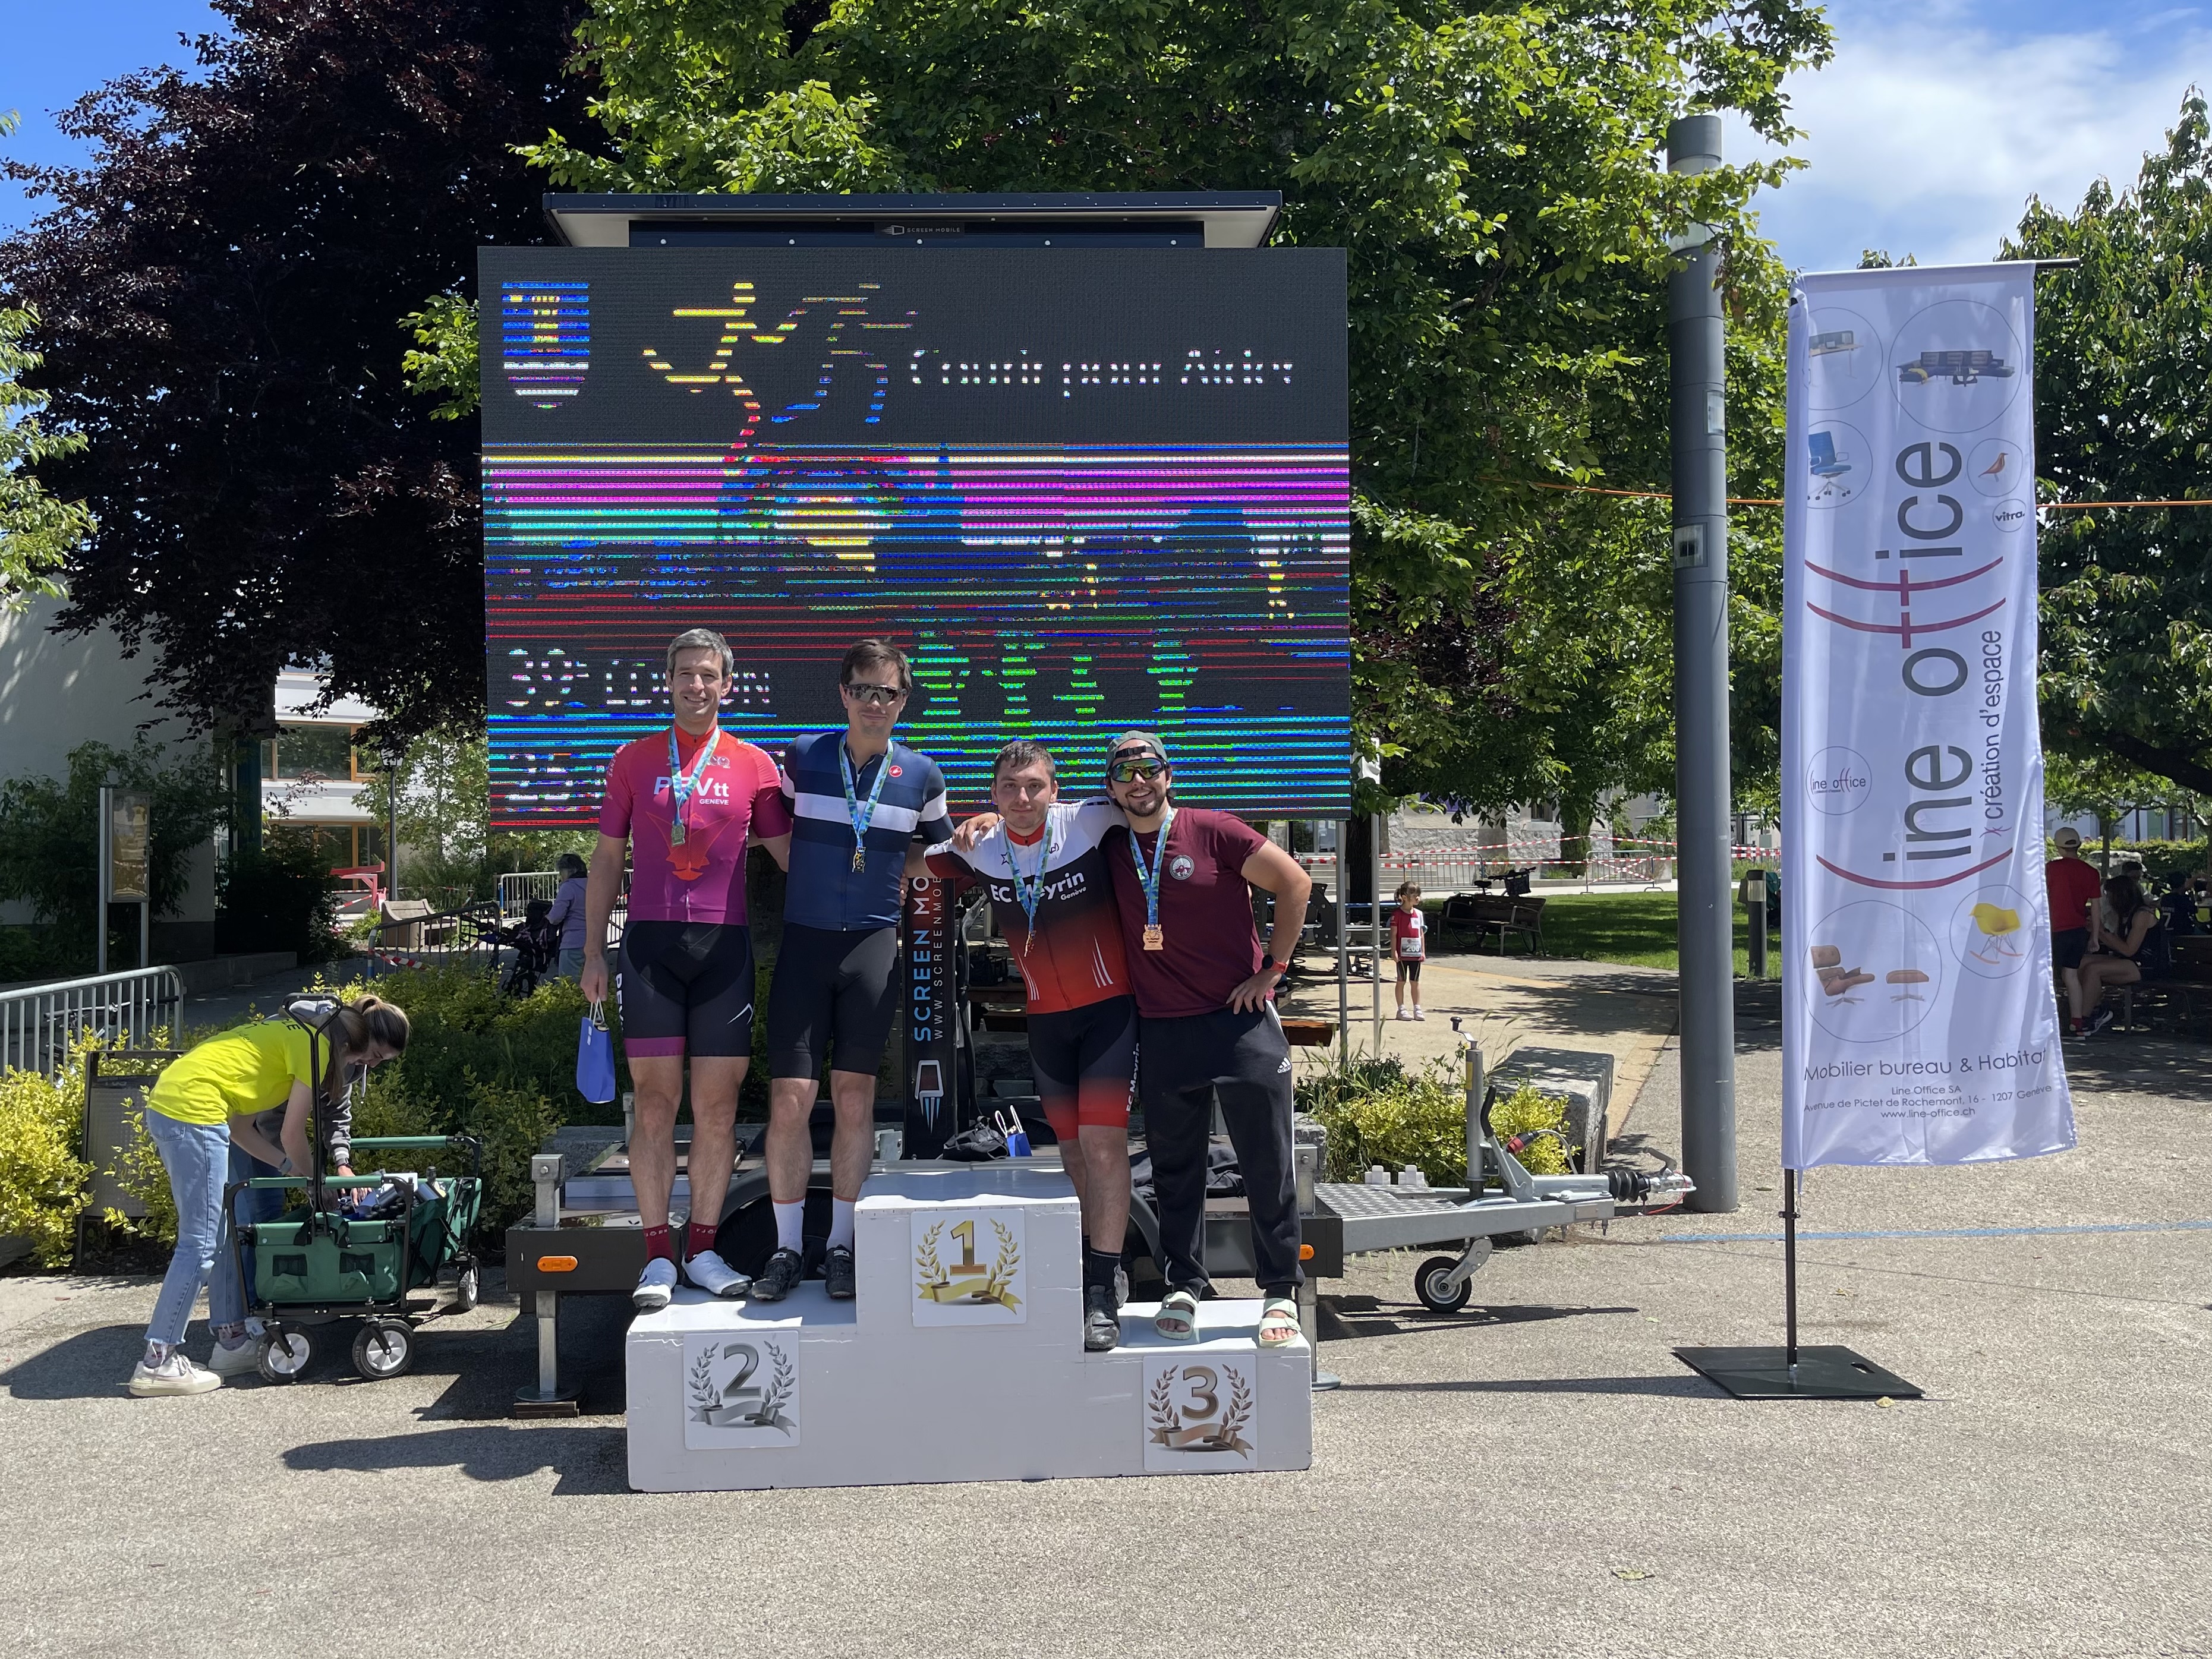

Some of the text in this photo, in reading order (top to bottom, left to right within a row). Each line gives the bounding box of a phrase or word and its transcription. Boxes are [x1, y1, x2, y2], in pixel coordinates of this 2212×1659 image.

[1980, 733, 2004, 820] création
[990, 884, 1012, 903] EC
[913, 930, 931, 1042] SCREEN
[1804, 1061, 1873, 1081] Mobilier
[1880, 1060, 1952, 1075] bureau
[1960, 1058, 1973, 1073] &
[1804, 1100, 1835, 1112] Avenue
[1838, 1099, 1851, 1108] de
[1854, 1099, 1883, 1107] Pictet
[1886, 1099, 1899, 1107] de
[1968, 1095, 1979, 1103] 16
[1992, 1092, 2013, 1102] 1207
[2016, 1085, 2052, 1099] Genève
[1892, 1085, 1962, 1096] Line Office SA
[1880, 1107, 1975, 1118] www.line-office.ch
[949, 1219, 987, 1276] 1
[723, 1342, 762, 1399] 2
[1181, 1365, 1219, 1421] 3
